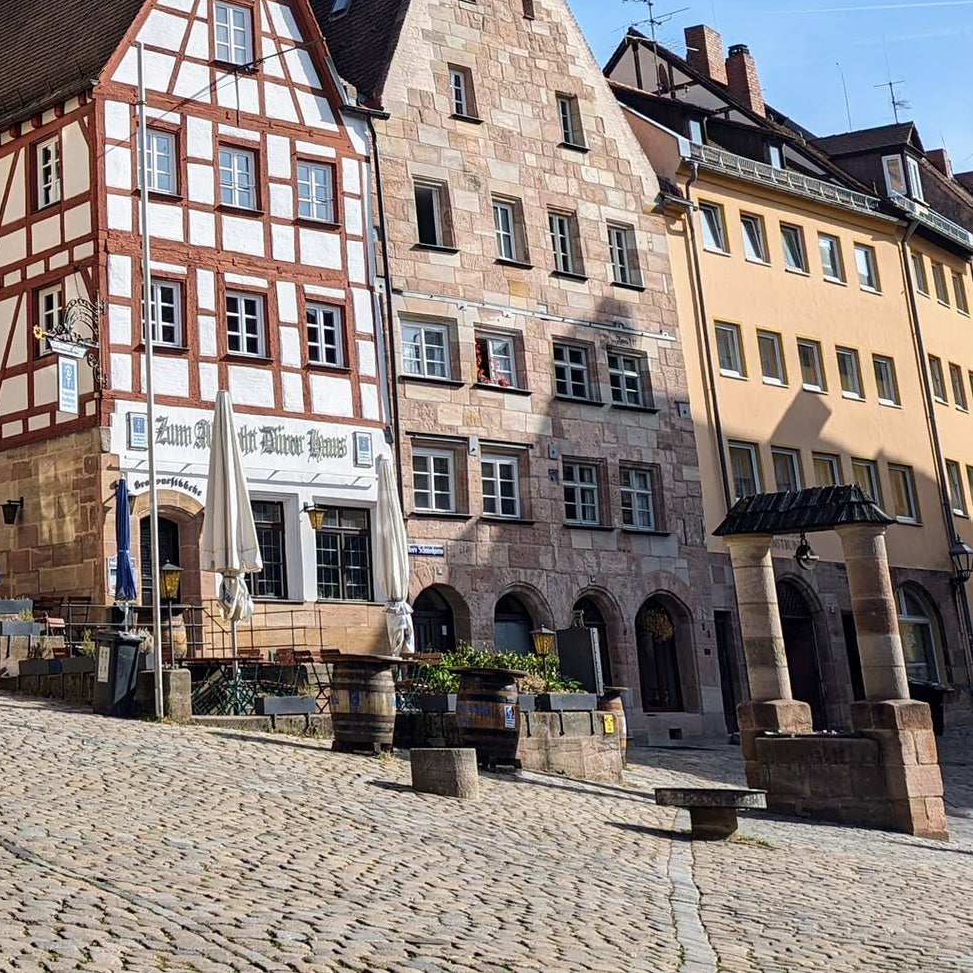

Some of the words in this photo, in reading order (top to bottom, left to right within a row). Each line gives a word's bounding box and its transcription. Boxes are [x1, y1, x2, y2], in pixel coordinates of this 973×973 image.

[155, 415, 193, 447] Zum
[259, 425, 305, 457] Dürer
[306, 428, 348, 463] Haus
